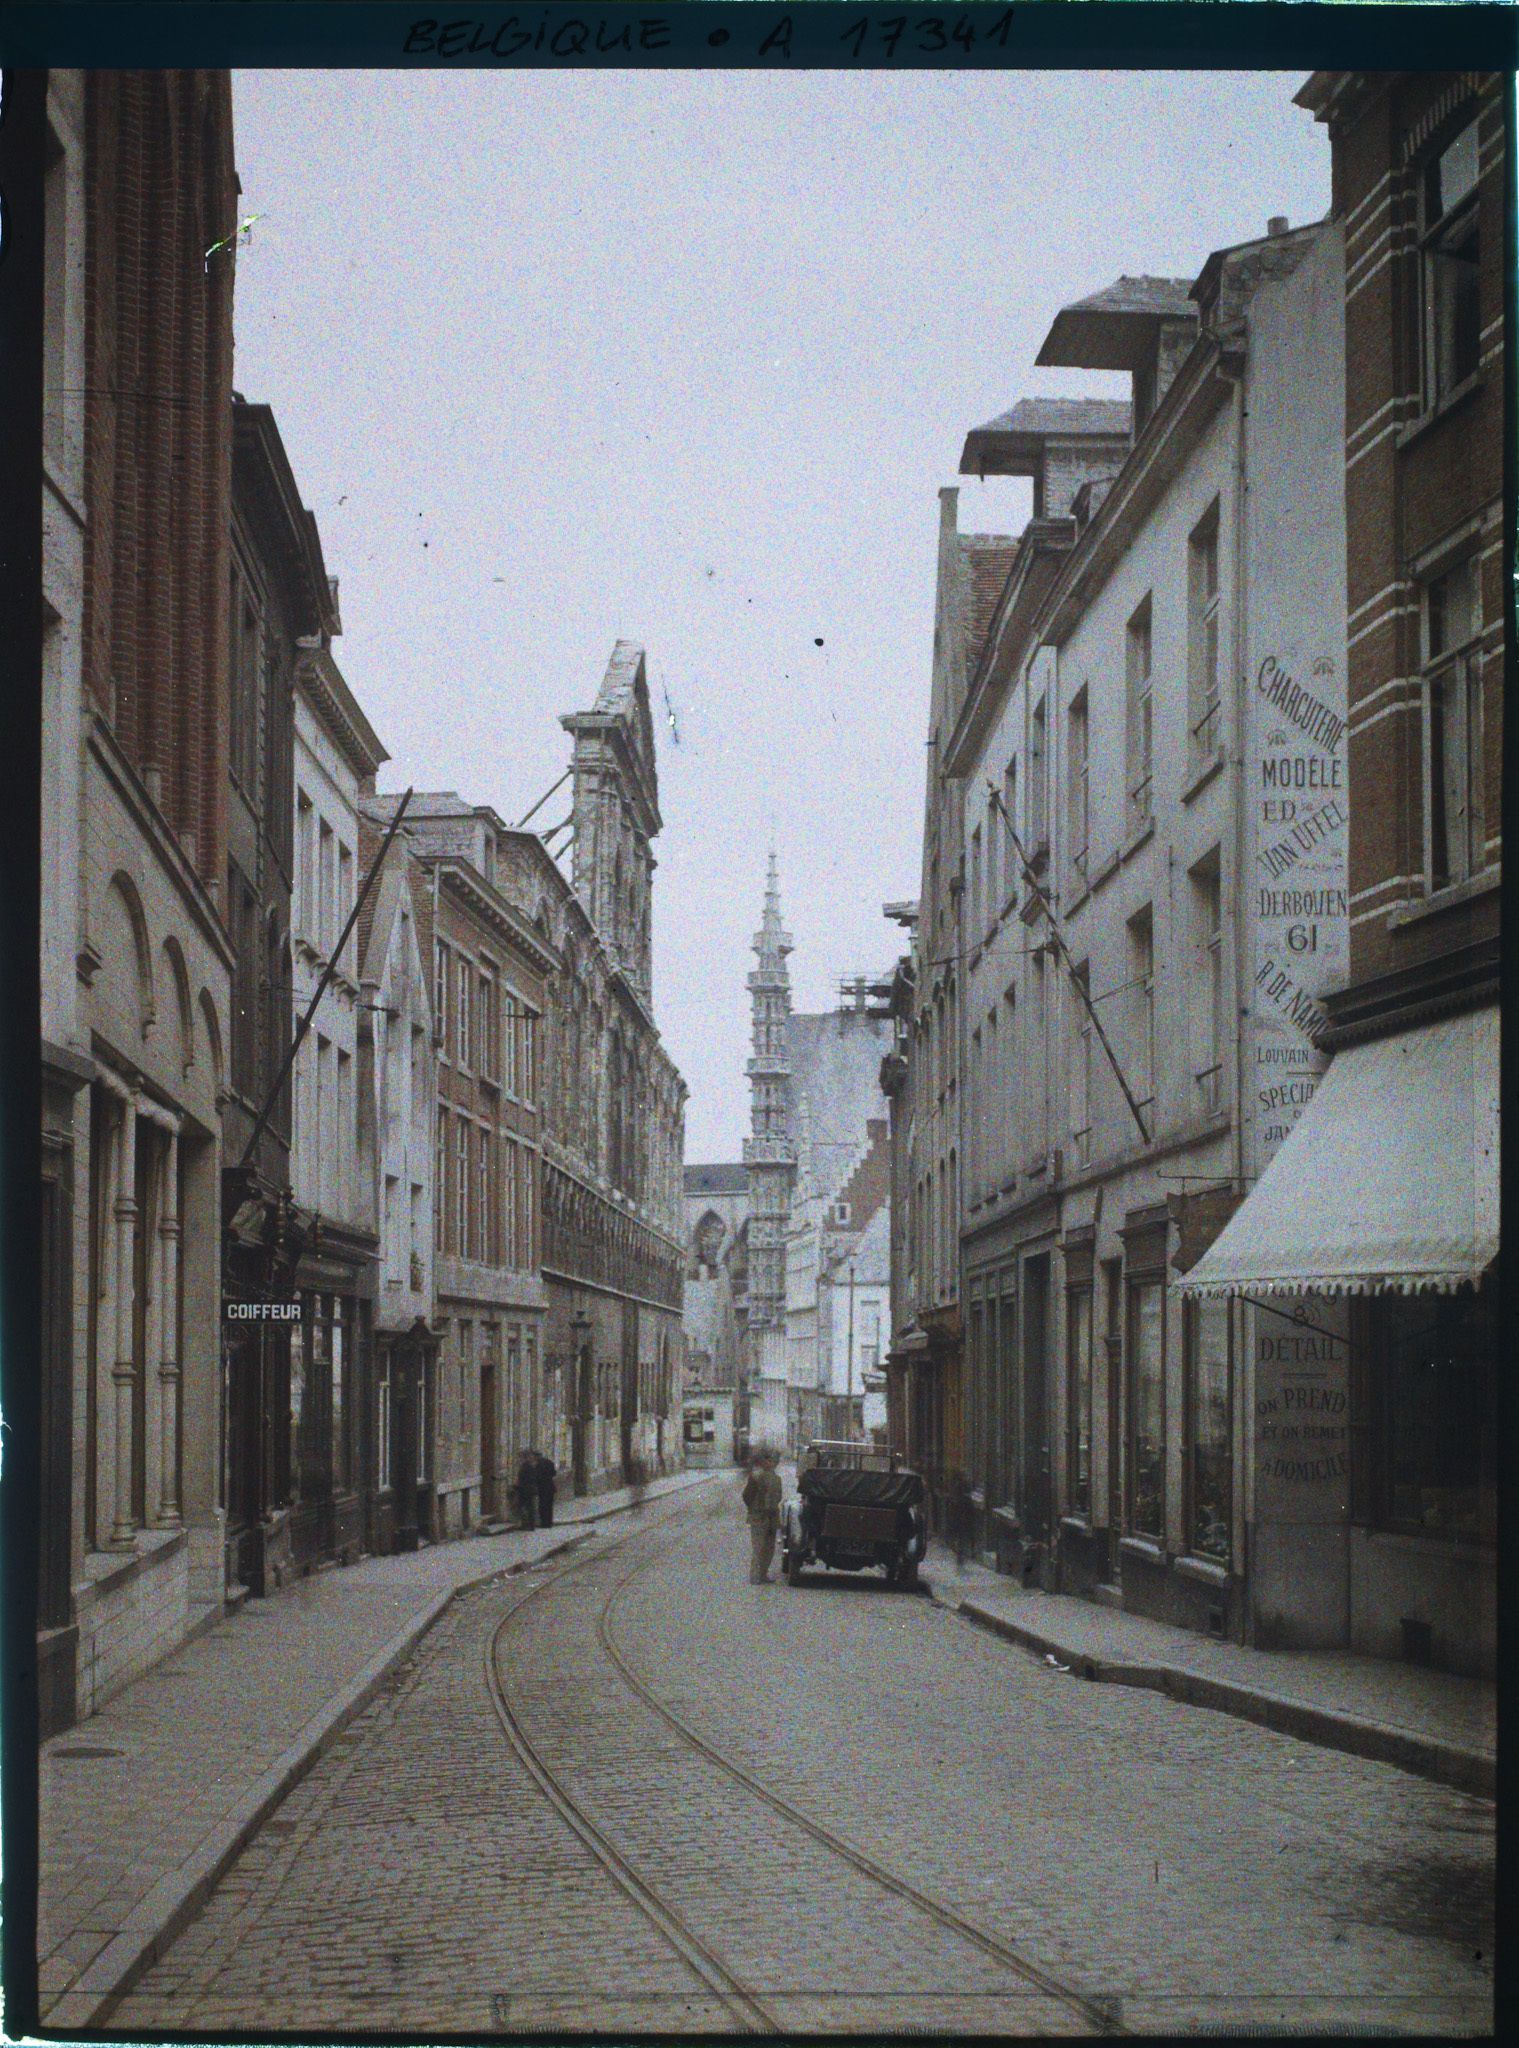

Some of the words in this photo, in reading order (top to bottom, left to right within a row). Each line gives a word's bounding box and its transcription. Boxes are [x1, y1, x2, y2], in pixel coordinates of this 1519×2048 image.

[758, 18, 793, 58] A
[839, 8, 1015, 59] 17341
[1258, 655, 1348, 754] CHARCUTERIE
[1256, 839, 1300, 880] VAN
[1291, 800, 1348, 851] UFFEL
[1287, 924, 1317, 952] 61
[1267, 971, 1293, 1003] DE
[1257, 1046, 1309, 1064] LOUVAIN
[227, 1303, 301, 1320] COIFFEUR
[1257, 1398, 1278, 1416] ON
[1282, 1387, 1347, 1414] PREND
[1281, 1426, 1299, 1440] ON
[1273, 1451, 1349, 1483] DOMICILE
